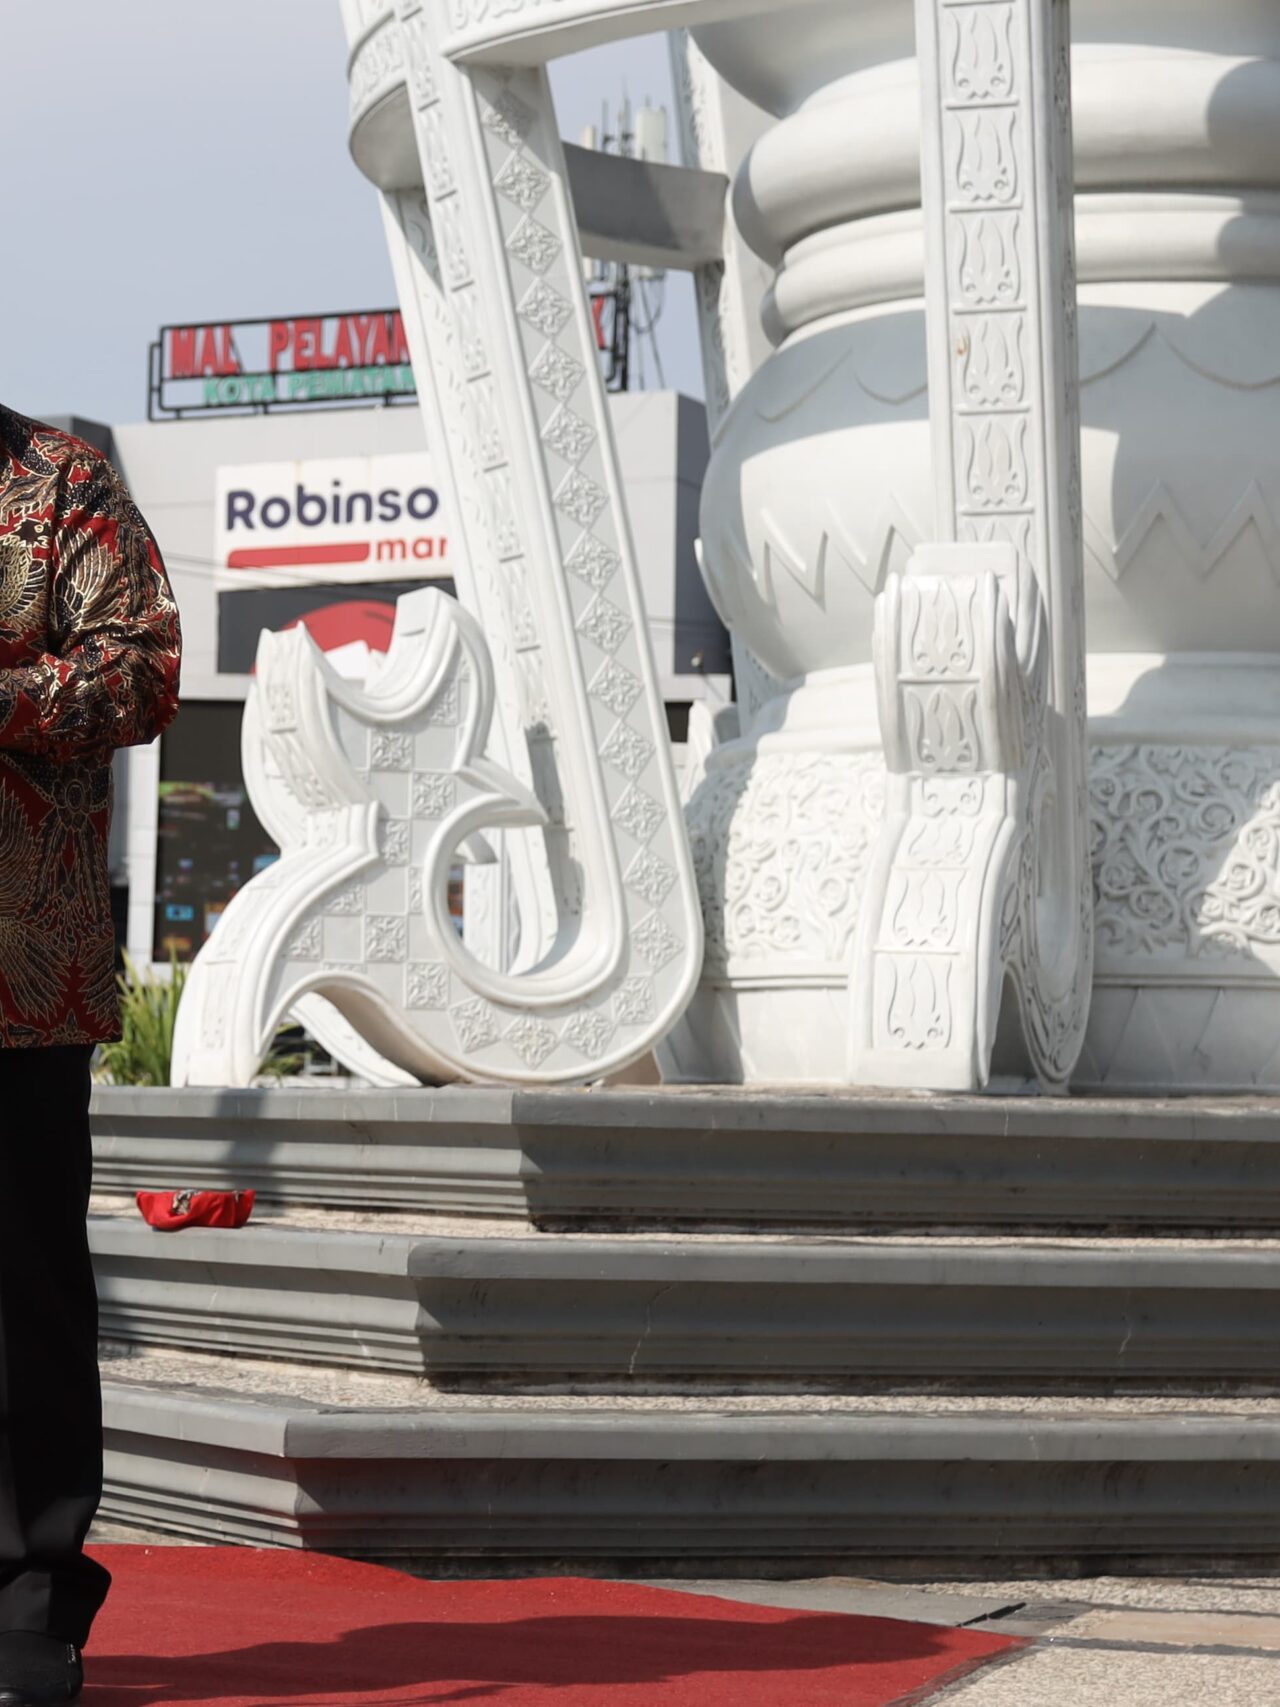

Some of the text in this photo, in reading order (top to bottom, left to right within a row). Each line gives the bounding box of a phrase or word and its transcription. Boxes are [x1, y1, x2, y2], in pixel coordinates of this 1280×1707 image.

[168, 324, 241, 378] MAL
[203, 374, 276, 404] KOTA
[226, 479, 440, 531] Robinso
